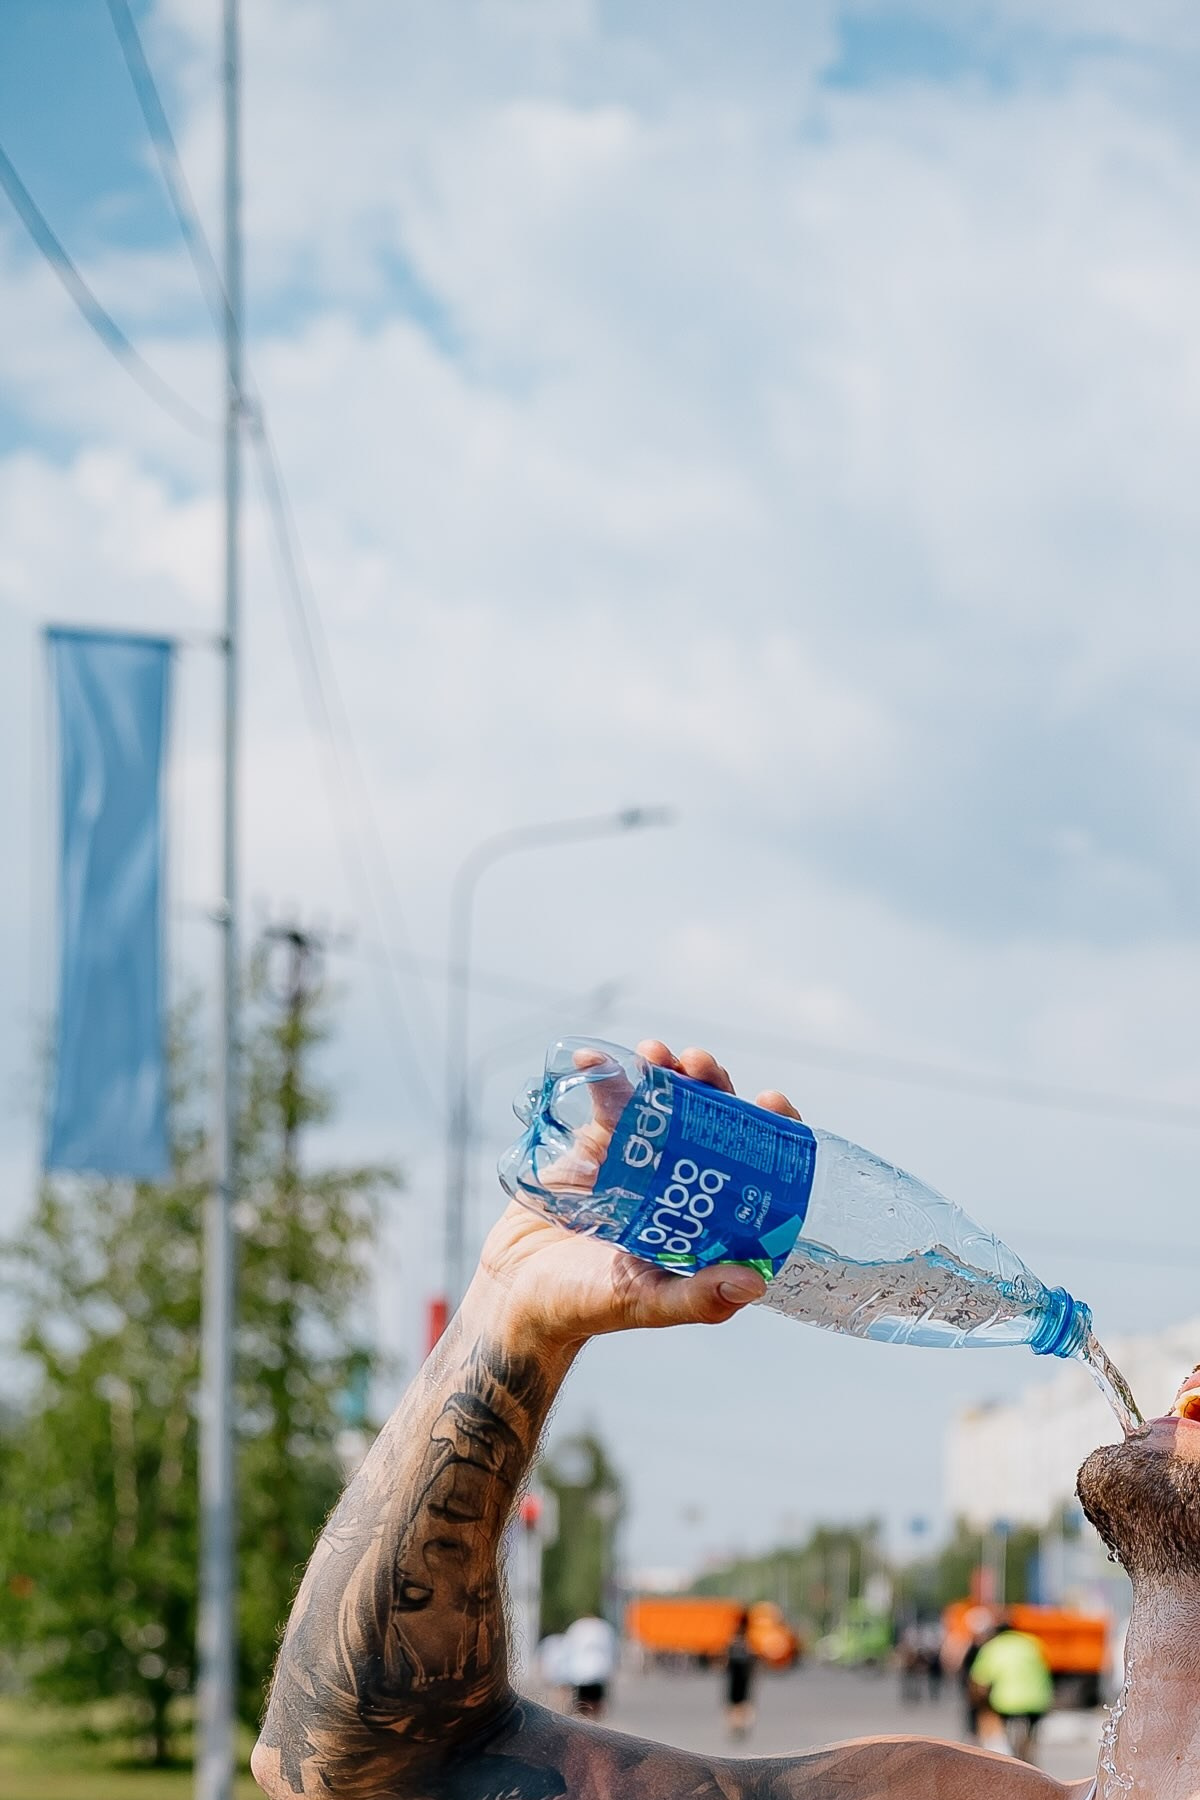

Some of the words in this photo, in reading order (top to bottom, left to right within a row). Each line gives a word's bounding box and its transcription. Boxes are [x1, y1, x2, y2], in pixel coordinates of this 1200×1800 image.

[638, 1158, 699, 1244] aqua
[663, 1169, 731, 1254] bona
[747, 1190, 757, 1200] Ca
